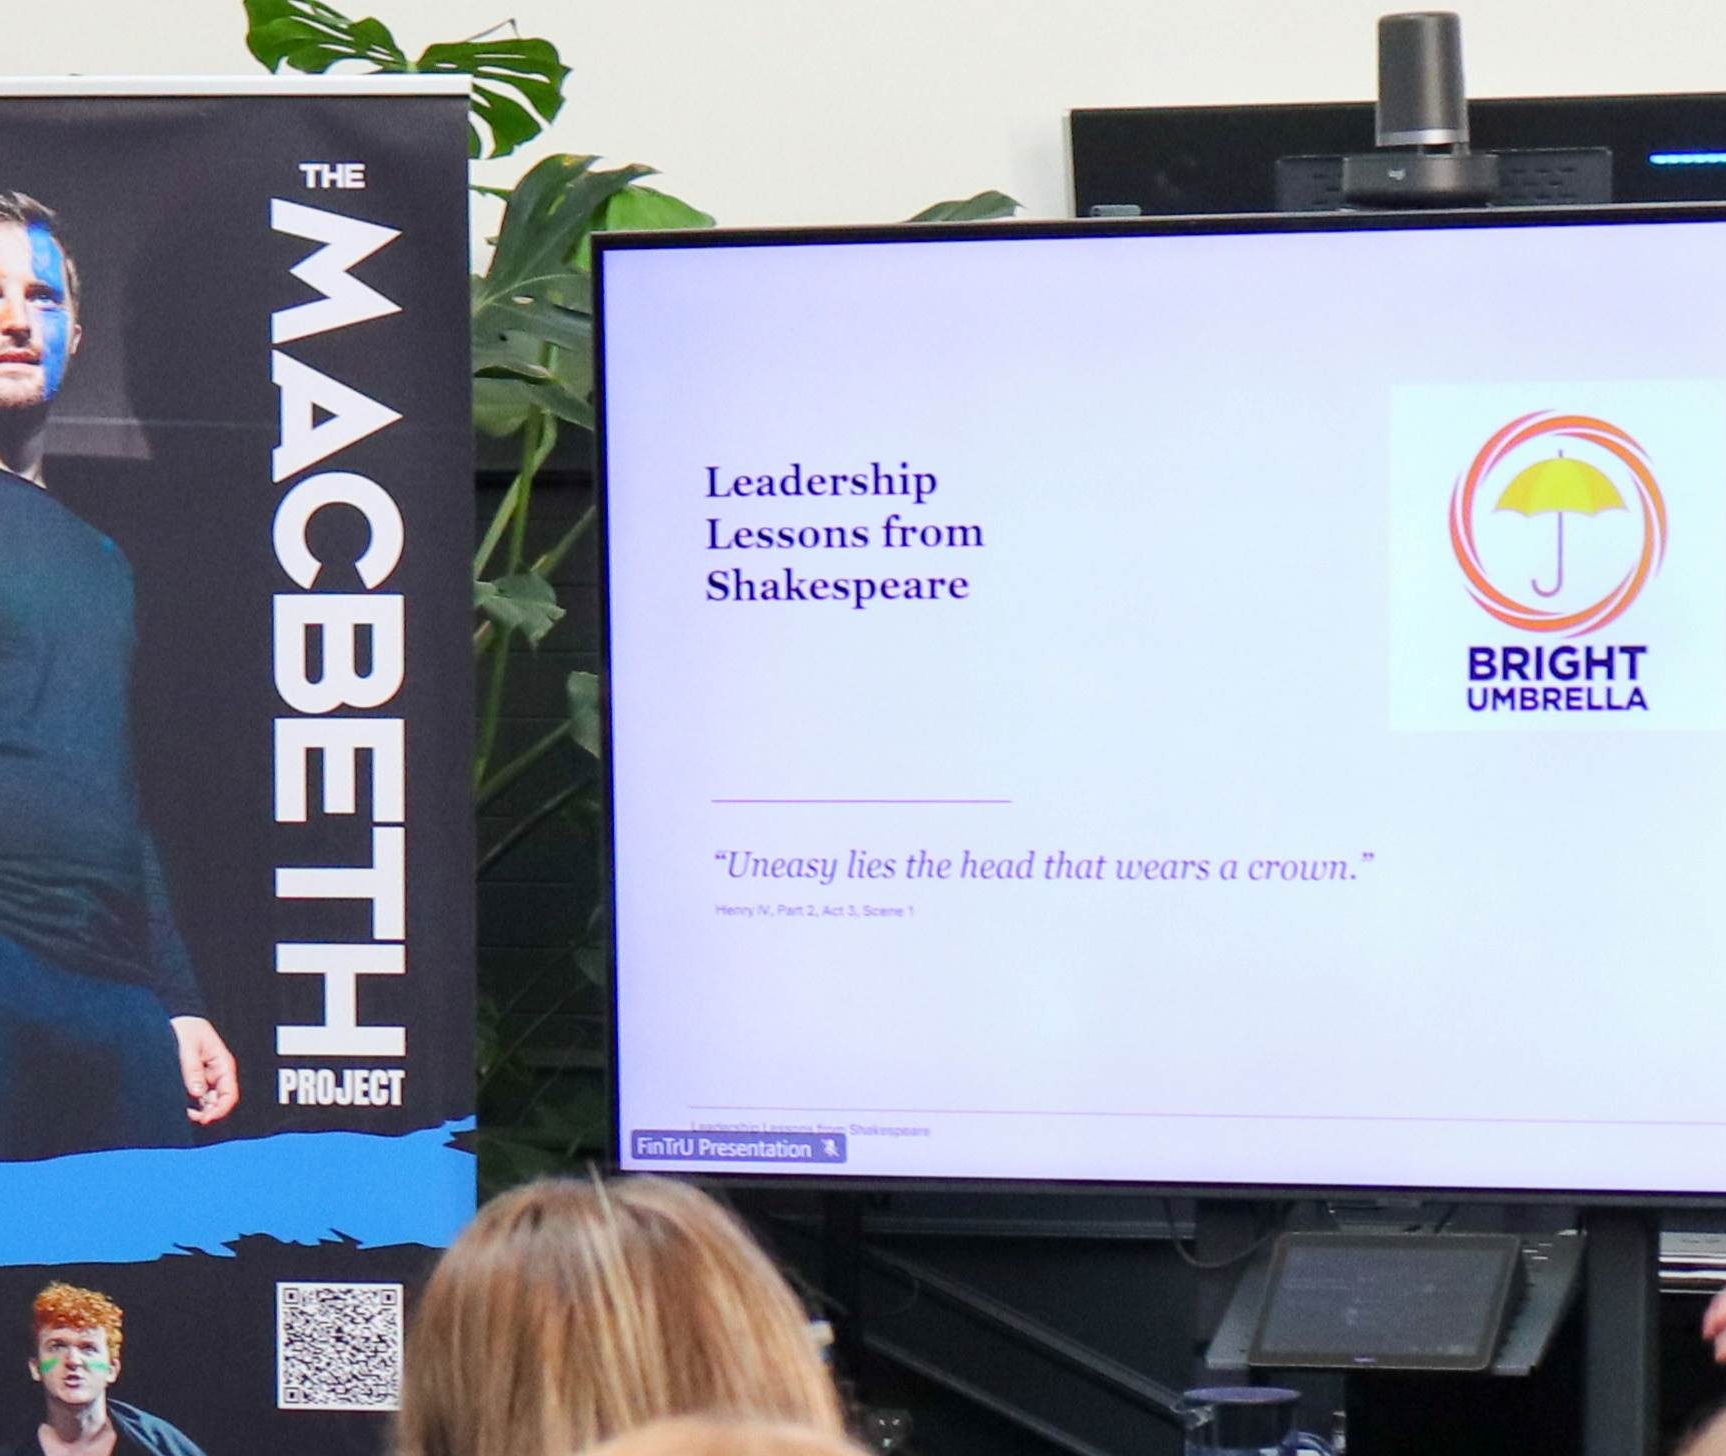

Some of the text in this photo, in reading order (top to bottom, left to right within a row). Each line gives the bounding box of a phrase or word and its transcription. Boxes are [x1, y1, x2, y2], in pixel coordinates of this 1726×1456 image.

[298, 163, 366, 189] THE
[705, 461, 937, 504] Leadership
[705, 513, 985, 550] Lessons from
[705, 567, 969, 610] Shakespeare
[270, 197, 407, 1056] MACBETH
[1468, 645, 1648, 681] BRIGHT
[1467, 686, 1649, 711] UMBRELLA
[714, 850, 839, 885] “Uneasy
[846, 850, 897, 879] lies
[905, 850, 953, 879] the
[960, 850, 1036, 879] head
[1043, 850, 1107, 881] that
[1116, 858, 1211, 881] wears
[1219, 859, 1238, 880] a
[715, 903, 754, 917] Henry
[777, 904, 804, 916] Part
[822, 904, 844, 916] Act
[863, 904, 904, 917] Scene
[277, 1068, 407, 1106] PROJECT
[636, 1137, 812, 1159] FinTrU Presentation
